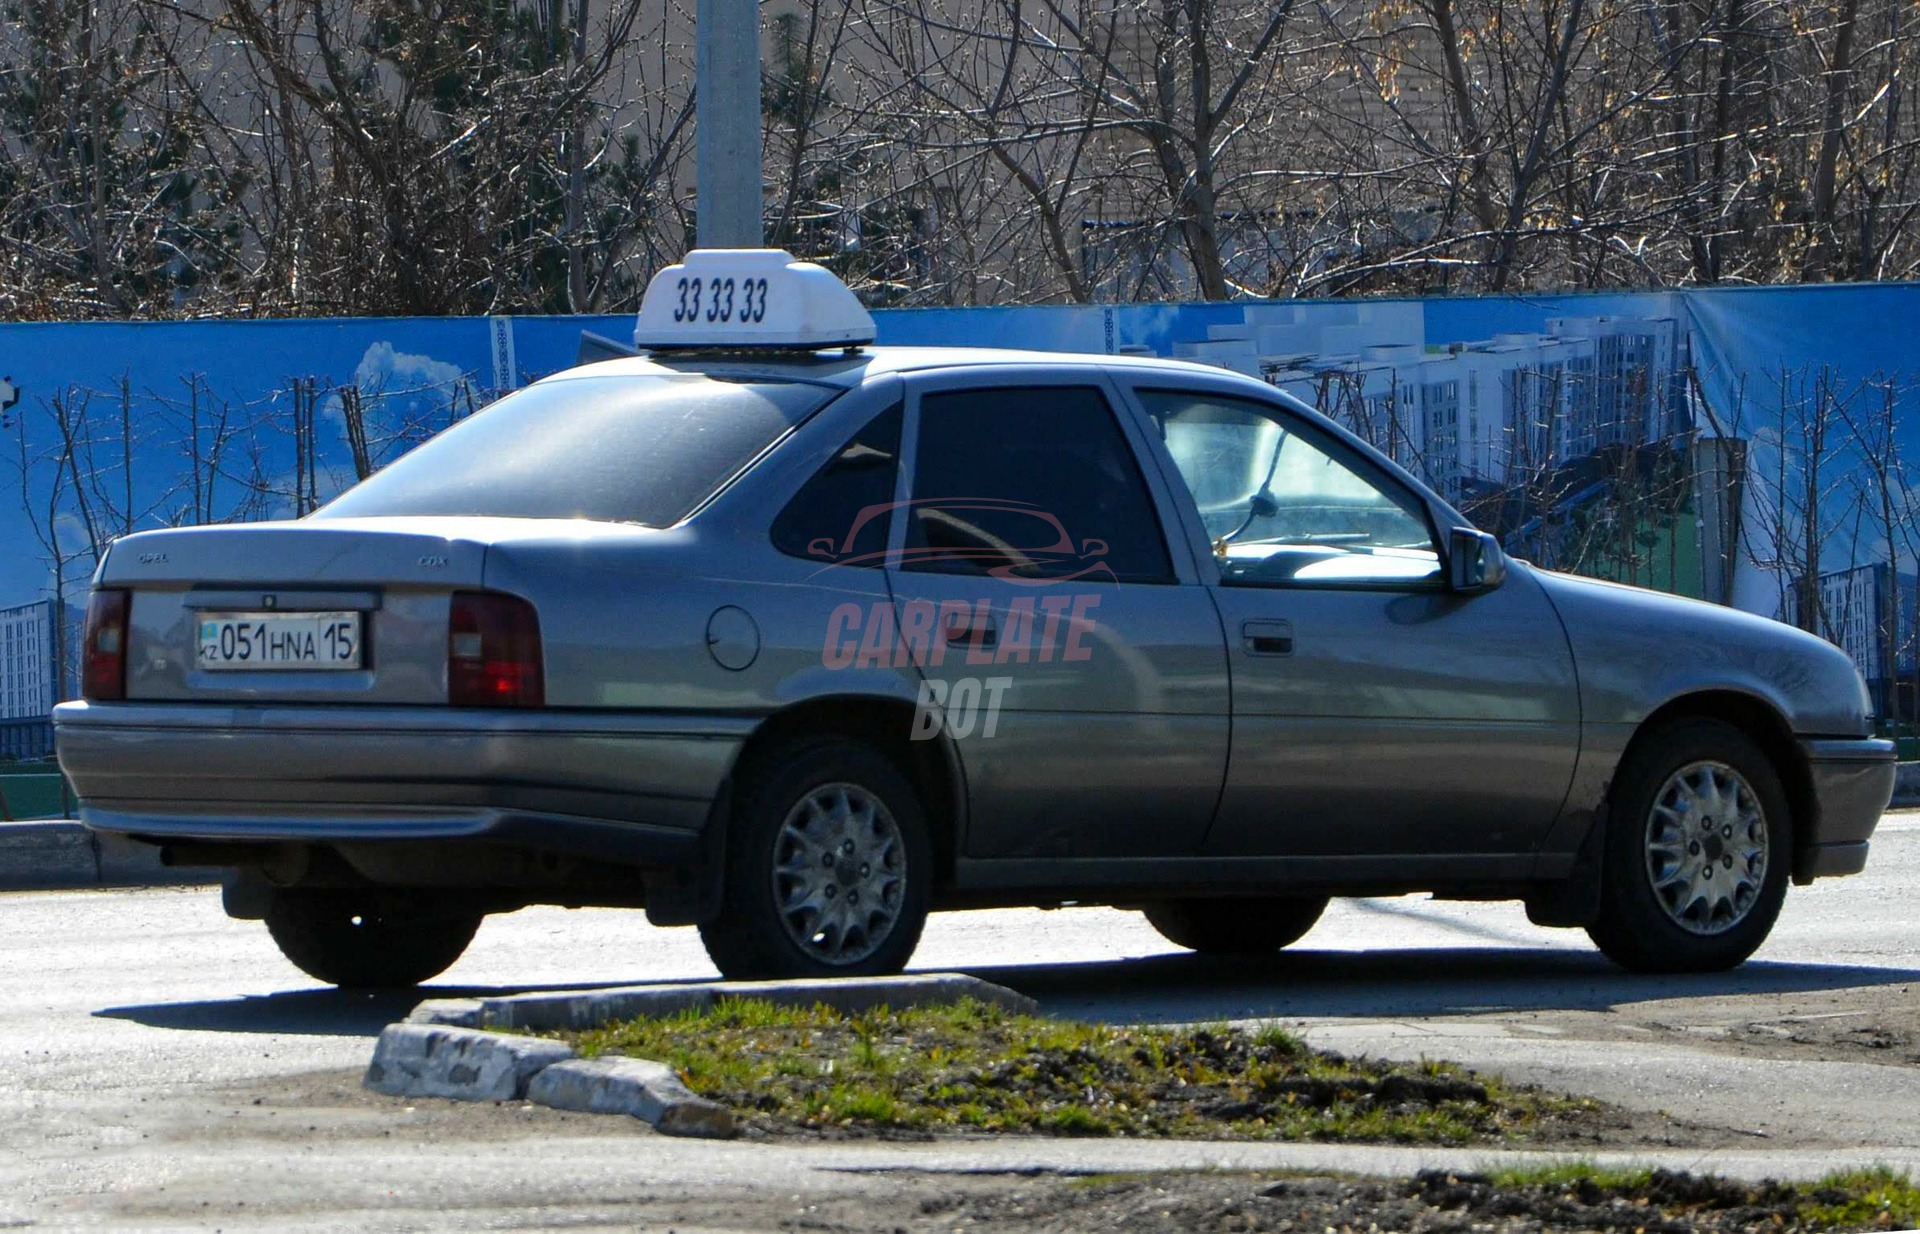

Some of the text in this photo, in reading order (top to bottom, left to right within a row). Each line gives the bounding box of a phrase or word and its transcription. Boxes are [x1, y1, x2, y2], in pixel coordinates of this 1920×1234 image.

[674, 277, 768, 323] 33 33 33
[200, 645, 217, 660] KZ
[324, 623, 351, 660] 15
